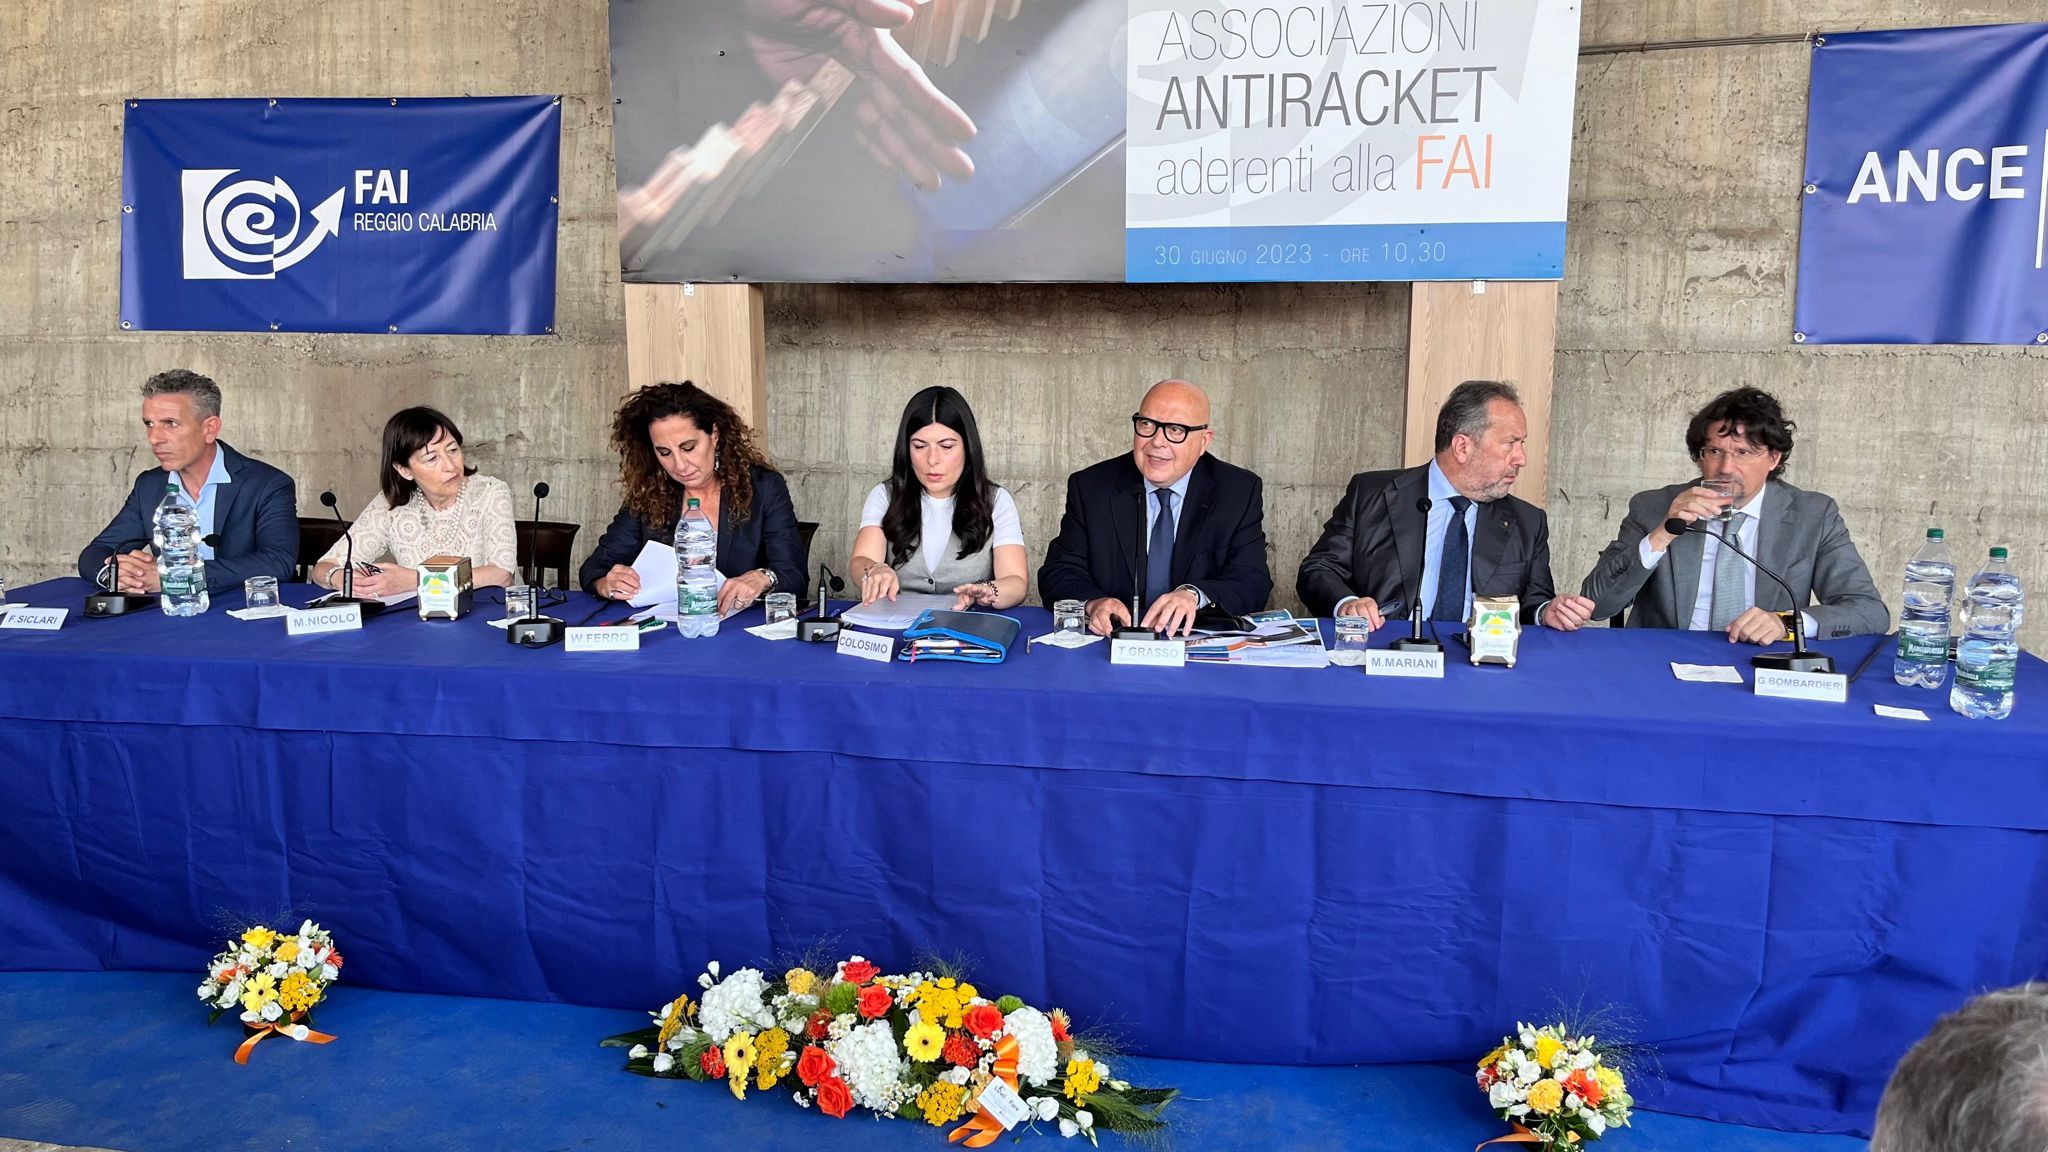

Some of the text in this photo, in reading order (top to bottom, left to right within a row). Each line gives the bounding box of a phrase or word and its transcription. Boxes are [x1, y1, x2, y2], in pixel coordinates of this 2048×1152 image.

[1157, 0, 1478, 61] ASSOCIAZIONI
[1156, 66, 1497, 130] ANTIRACKET
[1156, 134, 1493, 195] aderenti alla FAI
[1846, 145, 2028, 204] ANCE
[355, 169, 409, 204] FAI
[354, 212, 497, 231] REGGIO CALABRIA
[1154, 245, 1181, 265] 30
[1191, 249, 1247, 264] GIUGNO
[1256, 244, 1312, 263] 2023
[1340, 247, 1370, 262] ORE
[1381, 241, 1446, 262] 10,30
[8, 614, 58, 624] F.SICLARI
[570, 632, 629, 643] W.FERRO
[839, 636, 888, 654] COLOSIMO
[1118, 646, 1179, 658] T.GRASSO
[1371, 657, 1438, 669] M.MARIANI
